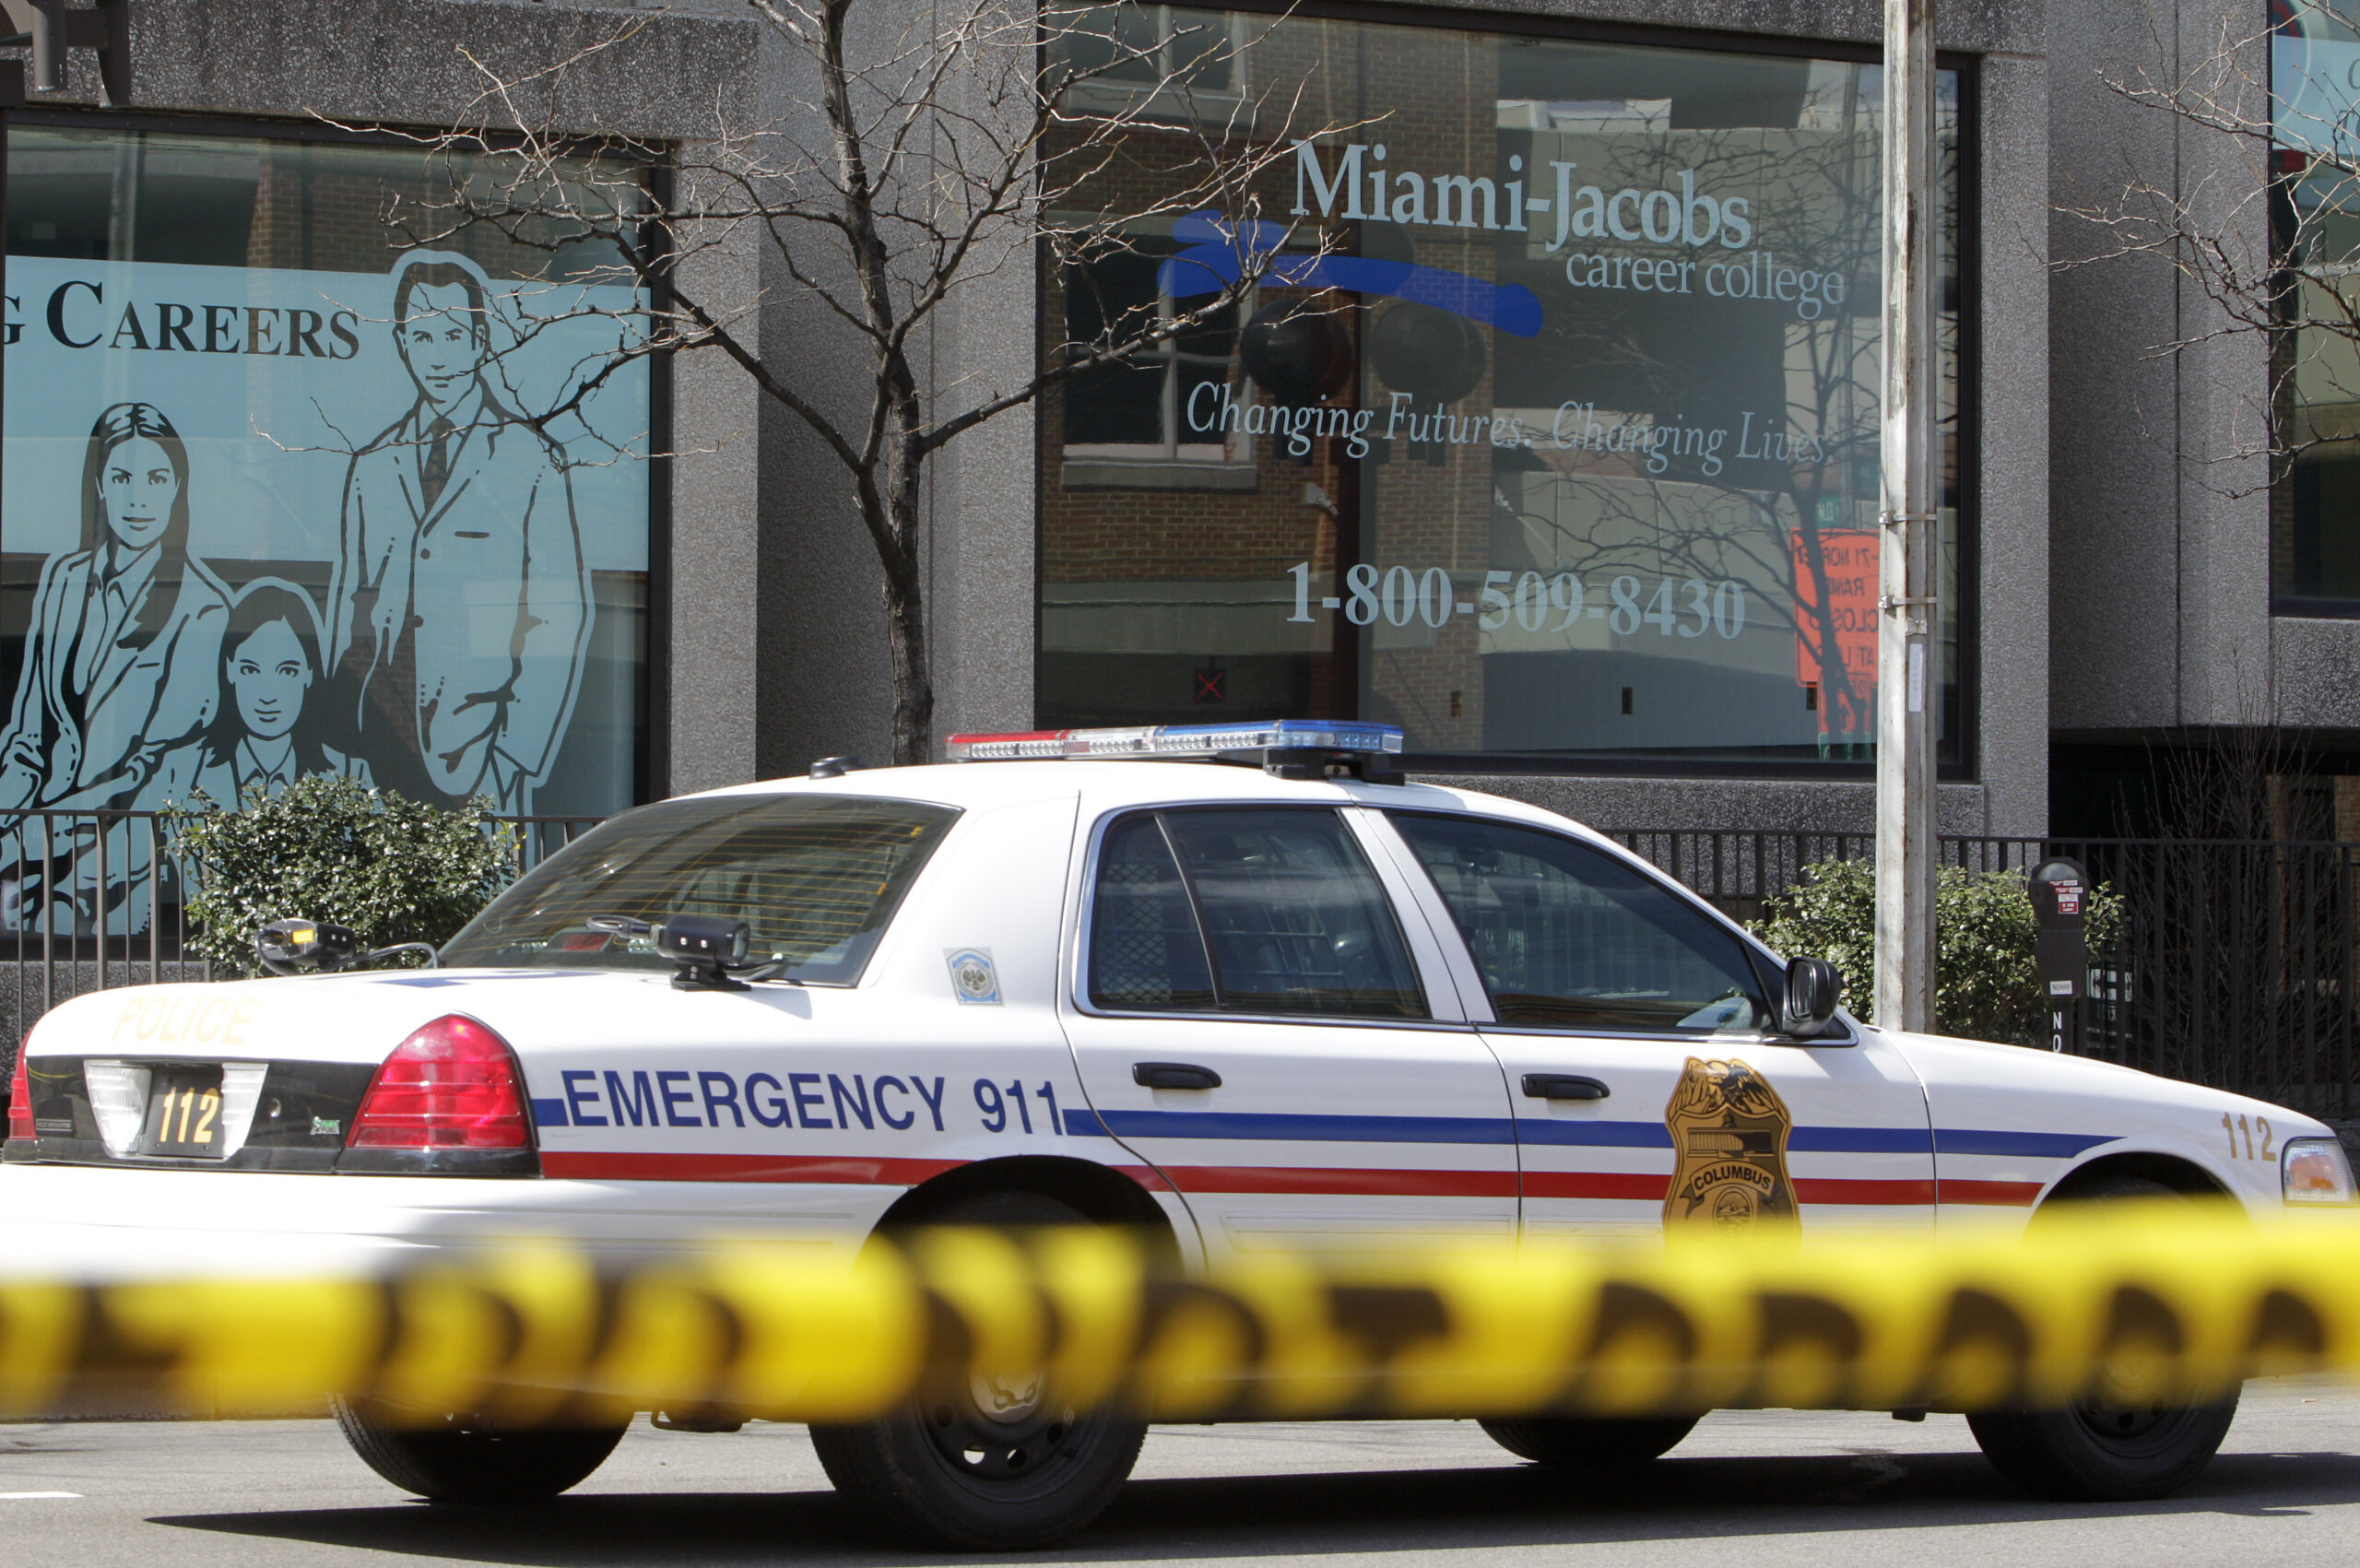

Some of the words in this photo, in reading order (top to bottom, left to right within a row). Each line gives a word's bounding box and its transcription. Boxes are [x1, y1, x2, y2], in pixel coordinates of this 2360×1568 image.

[1291, 138, 1751, 252] Miami-Jacobs
[1565, 252, 1693, 294] career
[1705, 250, 1845, 320] college
[1187, 380, 1375, 458] Changing
[1382, 391, 1532, 447] Futures.
[1552, 400, 1728, 476] Changing
[1734, 411, 1835, 464] Lives.
[1285, 560, 1747, 640] 1-800-509-8430
[111, 996, 264, 1045] POLICE
[159, 1086, 220, 1143] 112
[560, 1069, 946, 1132] EMERGENCY
[974, 1078, 1064, 1137] 911
[2221, 1111, 2277, 1161] 112
[1693, 1164, 1773, 1192] COLUMBUS
